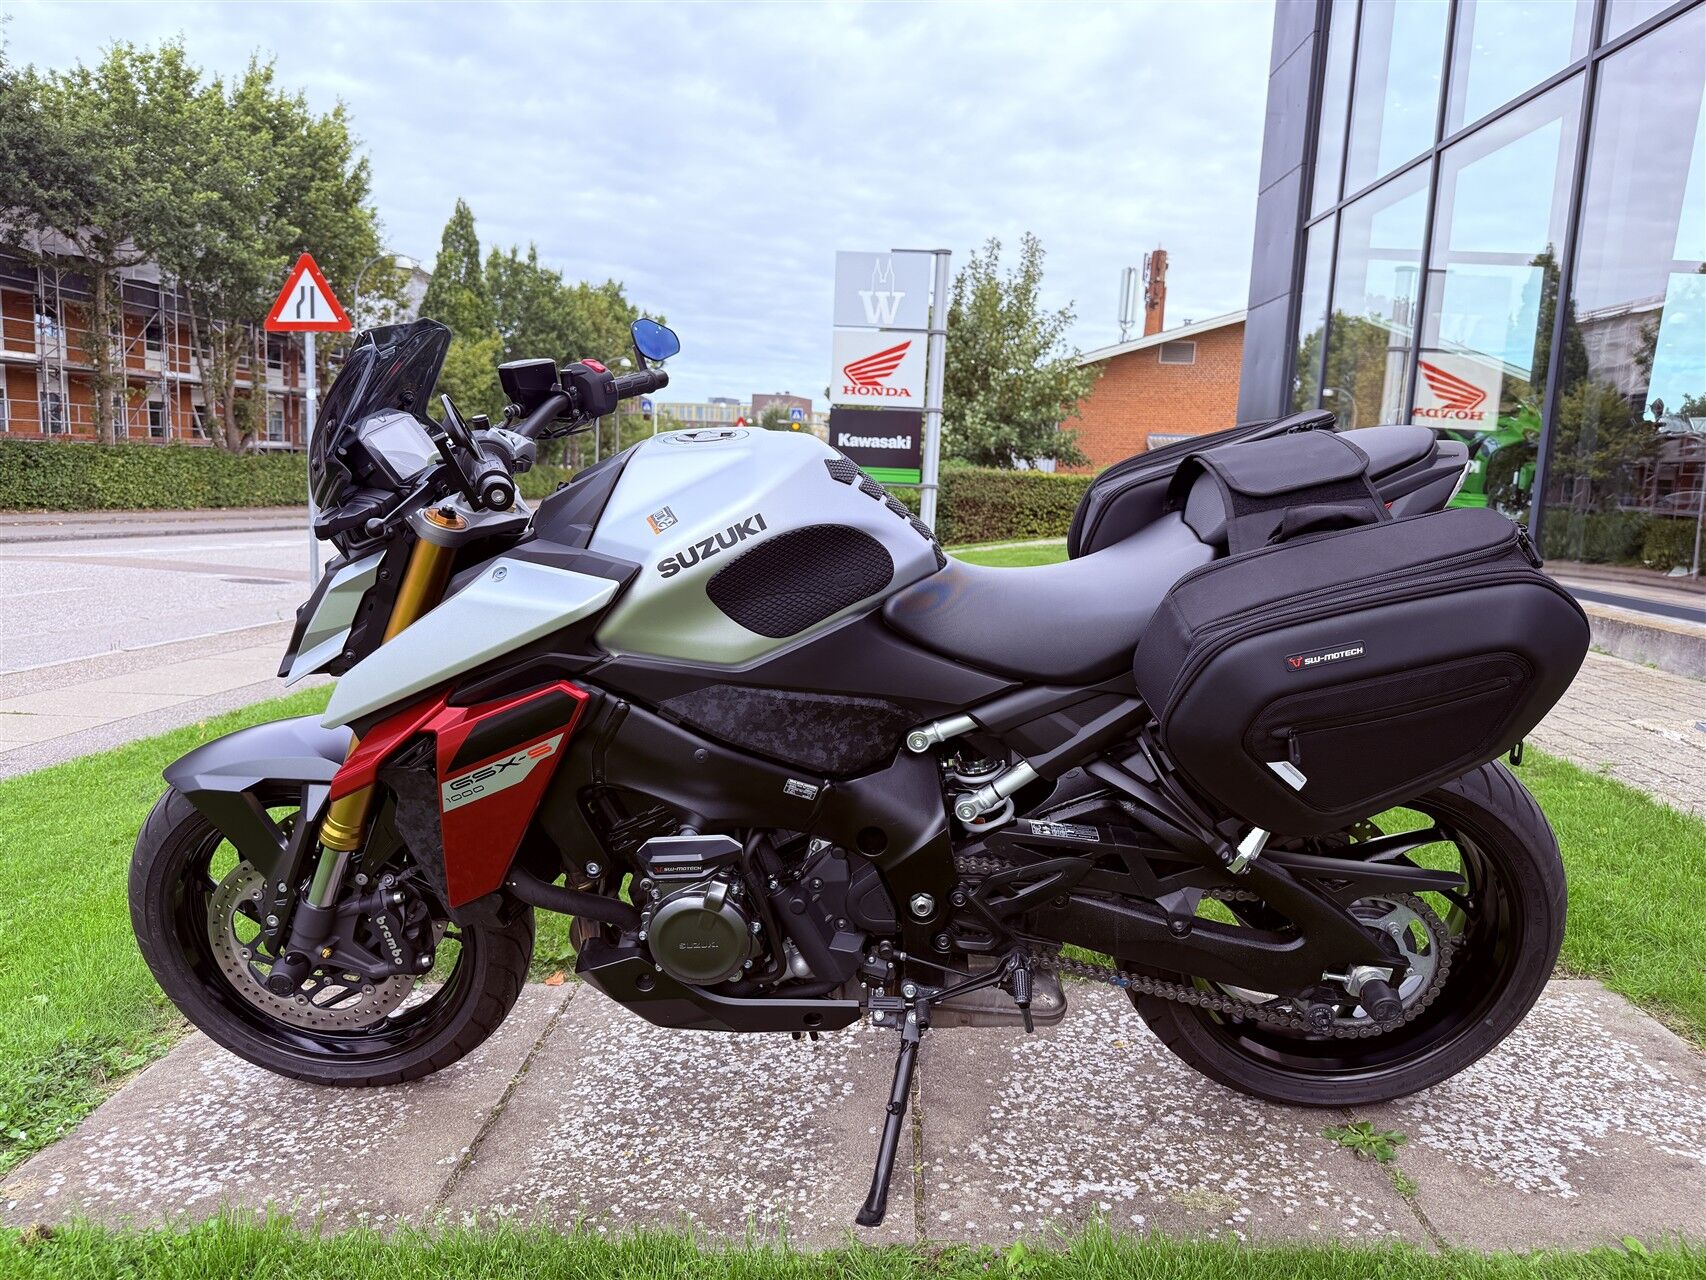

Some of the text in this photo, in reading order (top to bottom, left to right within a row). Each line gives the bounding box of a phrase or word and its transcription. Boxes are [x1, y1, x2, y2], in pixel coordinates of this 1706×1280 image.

[842, 385, 912, 398] HONDA
[838, 432, 912, 450] Kawasaki
[656, 512, 768, 579] SUZUKI
[1304, 647, 1363, 665] SW-MOTECH
[450, 743, 553, 791] GSX-S
[445, 785, 485, 803] 1000
[376, 915, 403, 965] brembo
